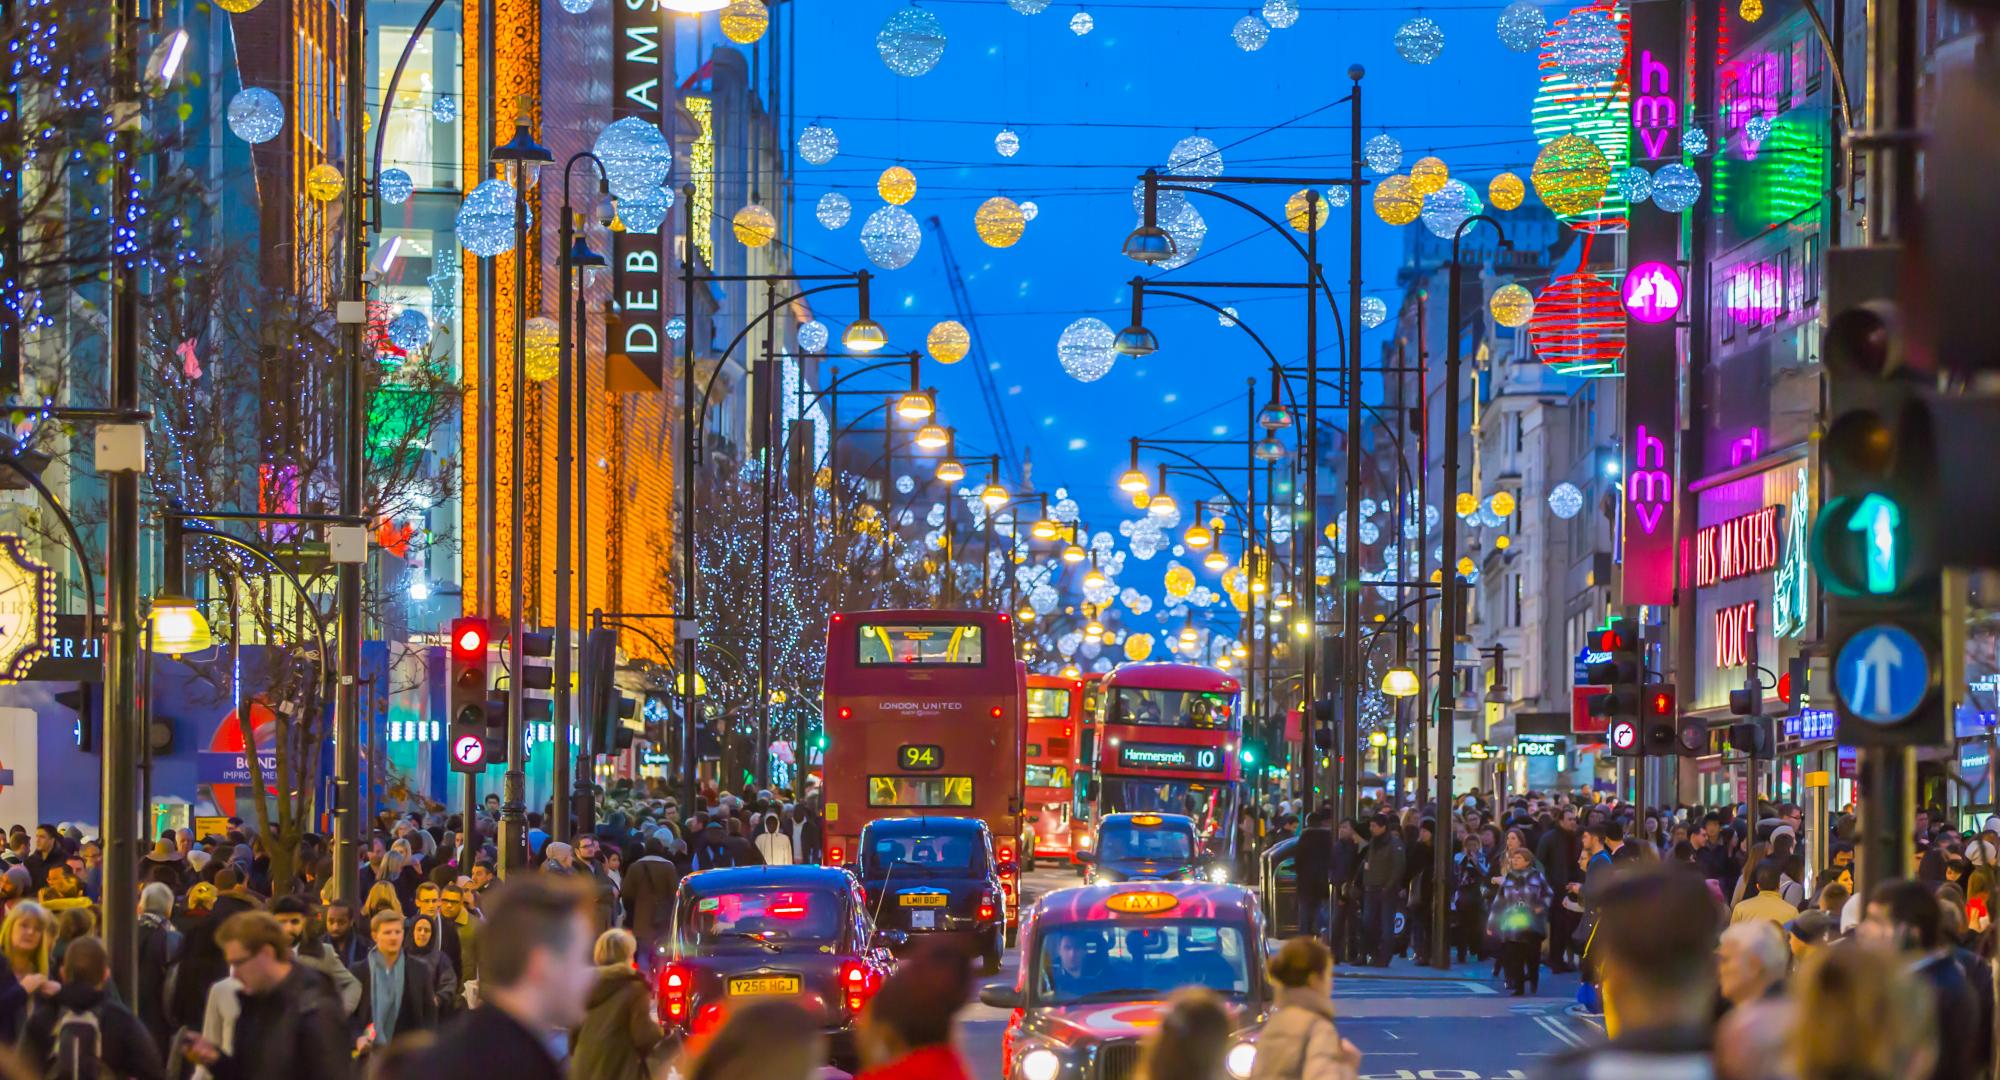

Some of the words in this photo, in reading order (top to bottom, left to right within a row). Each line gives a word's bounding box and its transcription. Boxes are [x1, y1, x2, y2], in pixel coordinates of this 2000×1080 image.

[1633, 50, 1676, 160] hmv
[1628, 424, 1671, 535] hmv
[1697, 525, 1716, 587] HIS
[1721, 508, 1776, 580] MASTER'S
[82, 638, 99, 658] 21
[879, 702, 918, 710] LONDON
[922, 702, 962, 710] UNITED
[907, 747, 934, 766] 94
[1124, 748, 1185, 763] Hammersmith
[1197, 750, 1215, 768] 10
[1518, 742, 1555, 756] next
[1122, 894, 1160, 909] TAXI
[735, 981, 766, 993] Y256
